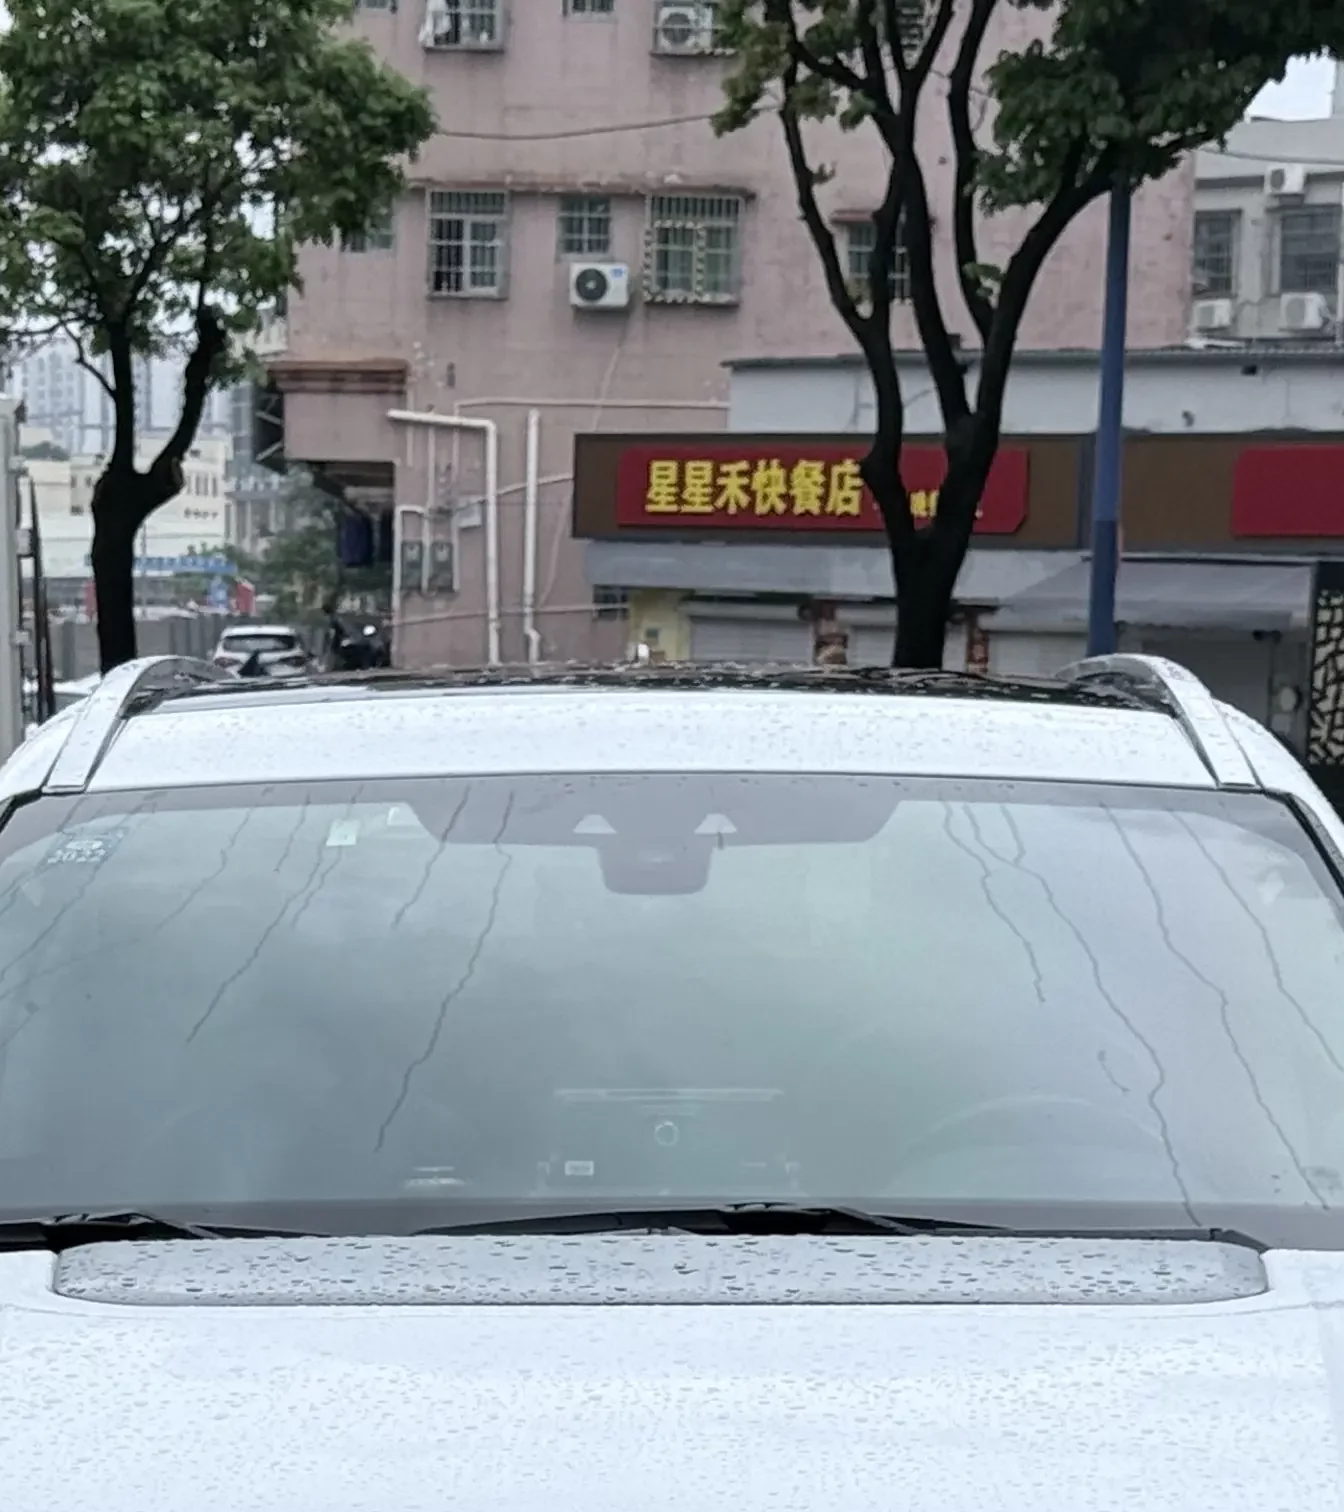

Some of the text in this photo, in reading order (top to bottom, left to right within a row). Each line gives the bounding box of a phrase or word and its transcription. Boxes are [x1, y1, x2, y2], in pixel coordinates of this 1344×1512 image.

[644, 459, 864, 517] 星星禾快餐店
